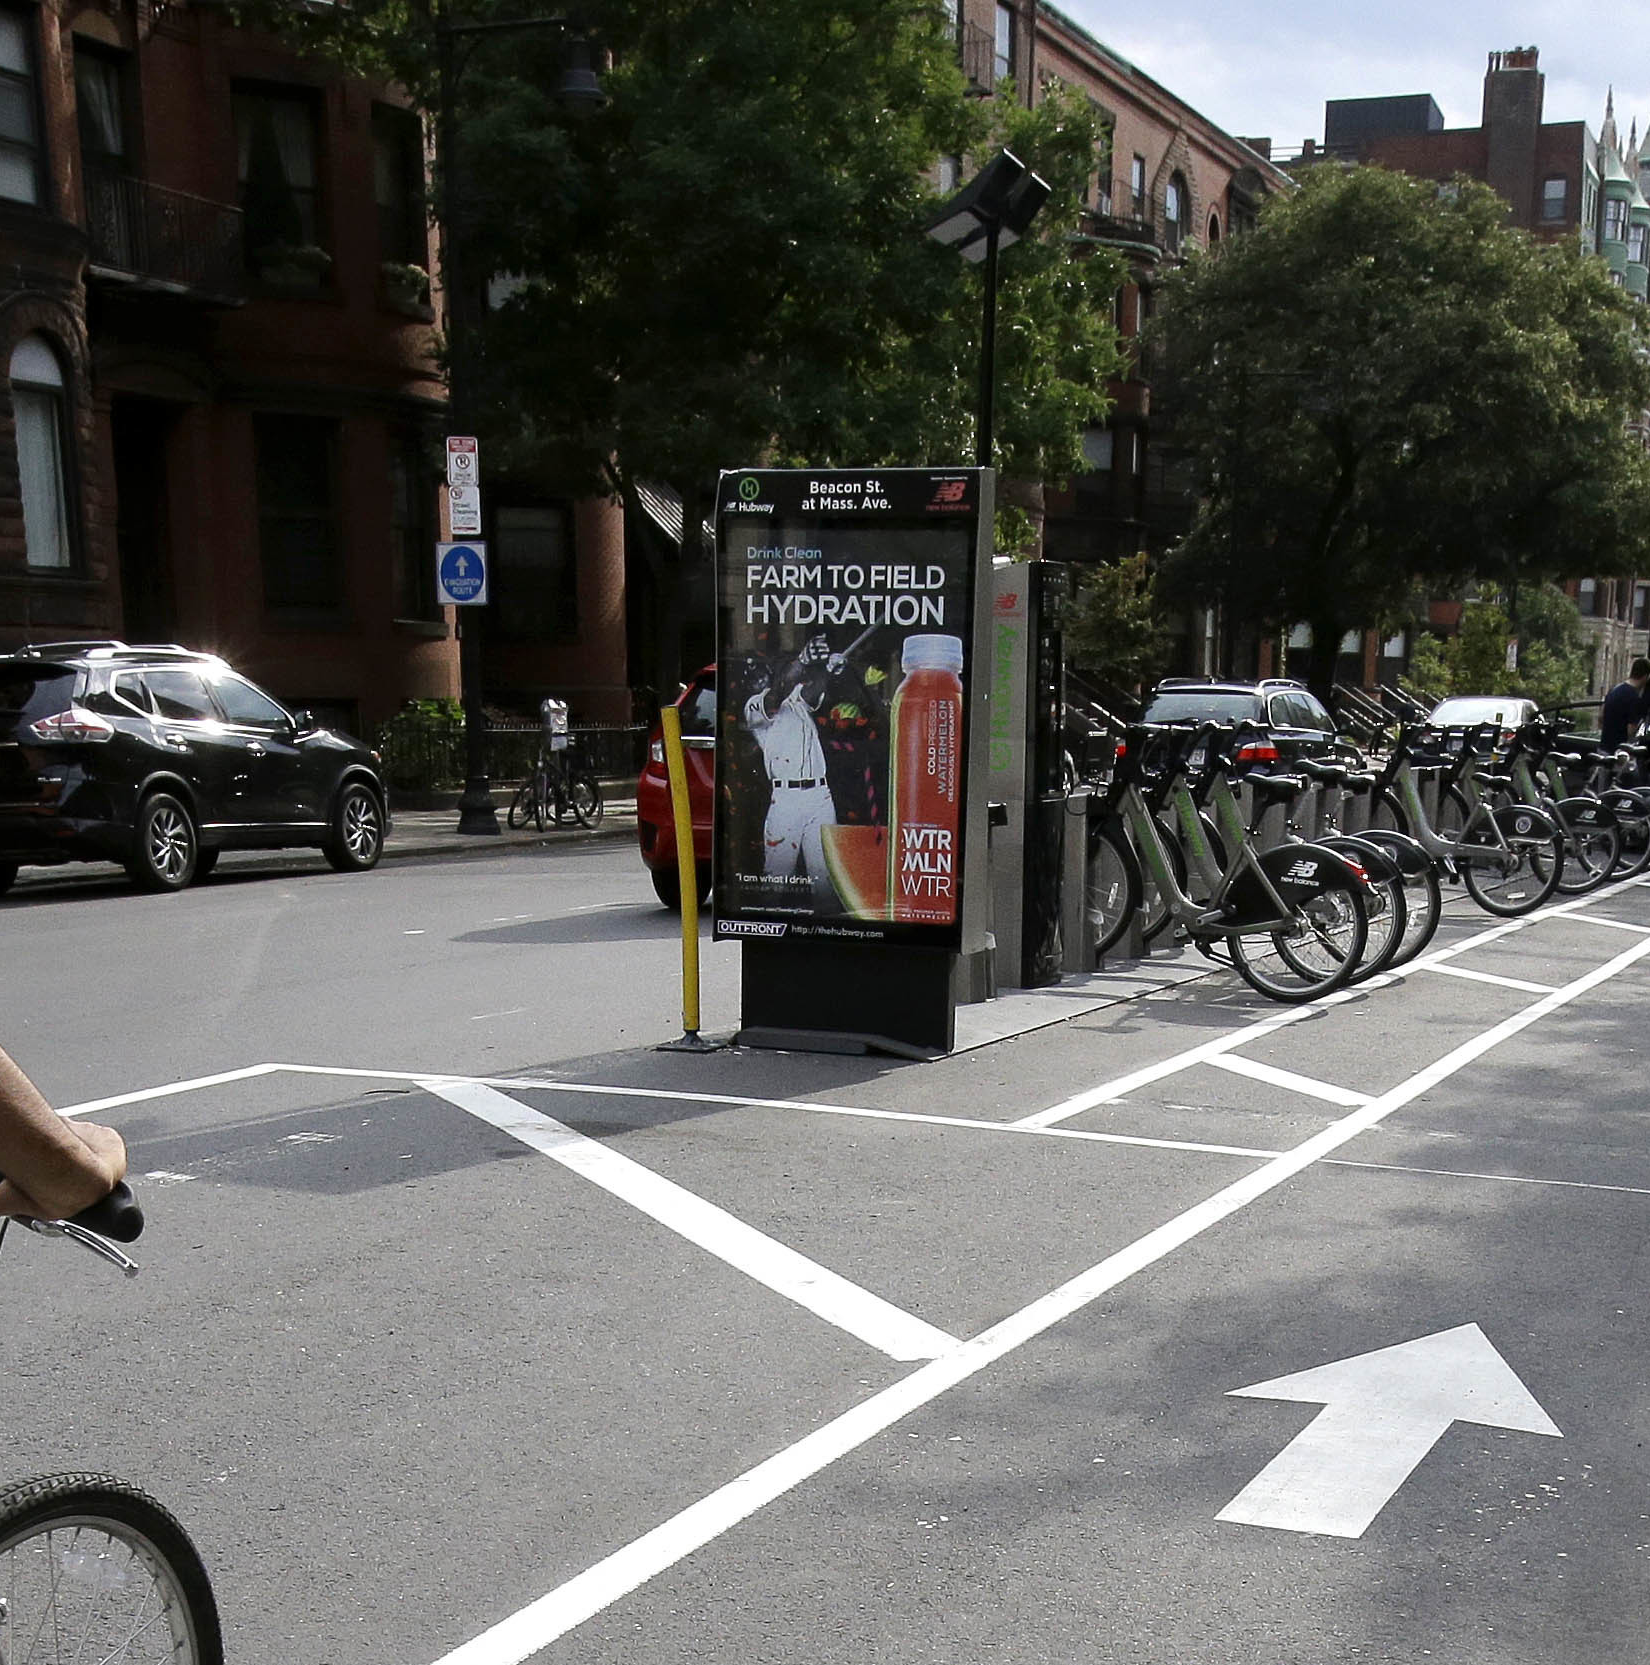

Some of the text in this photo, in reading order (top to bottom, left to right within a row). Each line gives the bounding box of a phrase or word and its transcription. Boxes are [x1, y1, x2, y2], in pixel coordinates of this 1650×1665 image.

[810, 480, 884, 493] Beacon St.
[739, 502, 774, 514] Hubway
[802, 497, 892, 510] at Mass. Ave.
[747, 546, 822, 559] Drink Clean
[747, 565, 945, 589] FARM TO FIELD
[747, 595, 944, 625] HYDRATION
[938, 700, 948, 794] WATERMELON
[928, 746, 936, 775] COLD
[902, 828, 951, 850] WTR
[902, 852, 951, 873] MLN
[760, 875, 783, 883] what
[721, 922, 782, 935] OUTFRONT
[791, 924, 884, 939] http://thehubway.com
